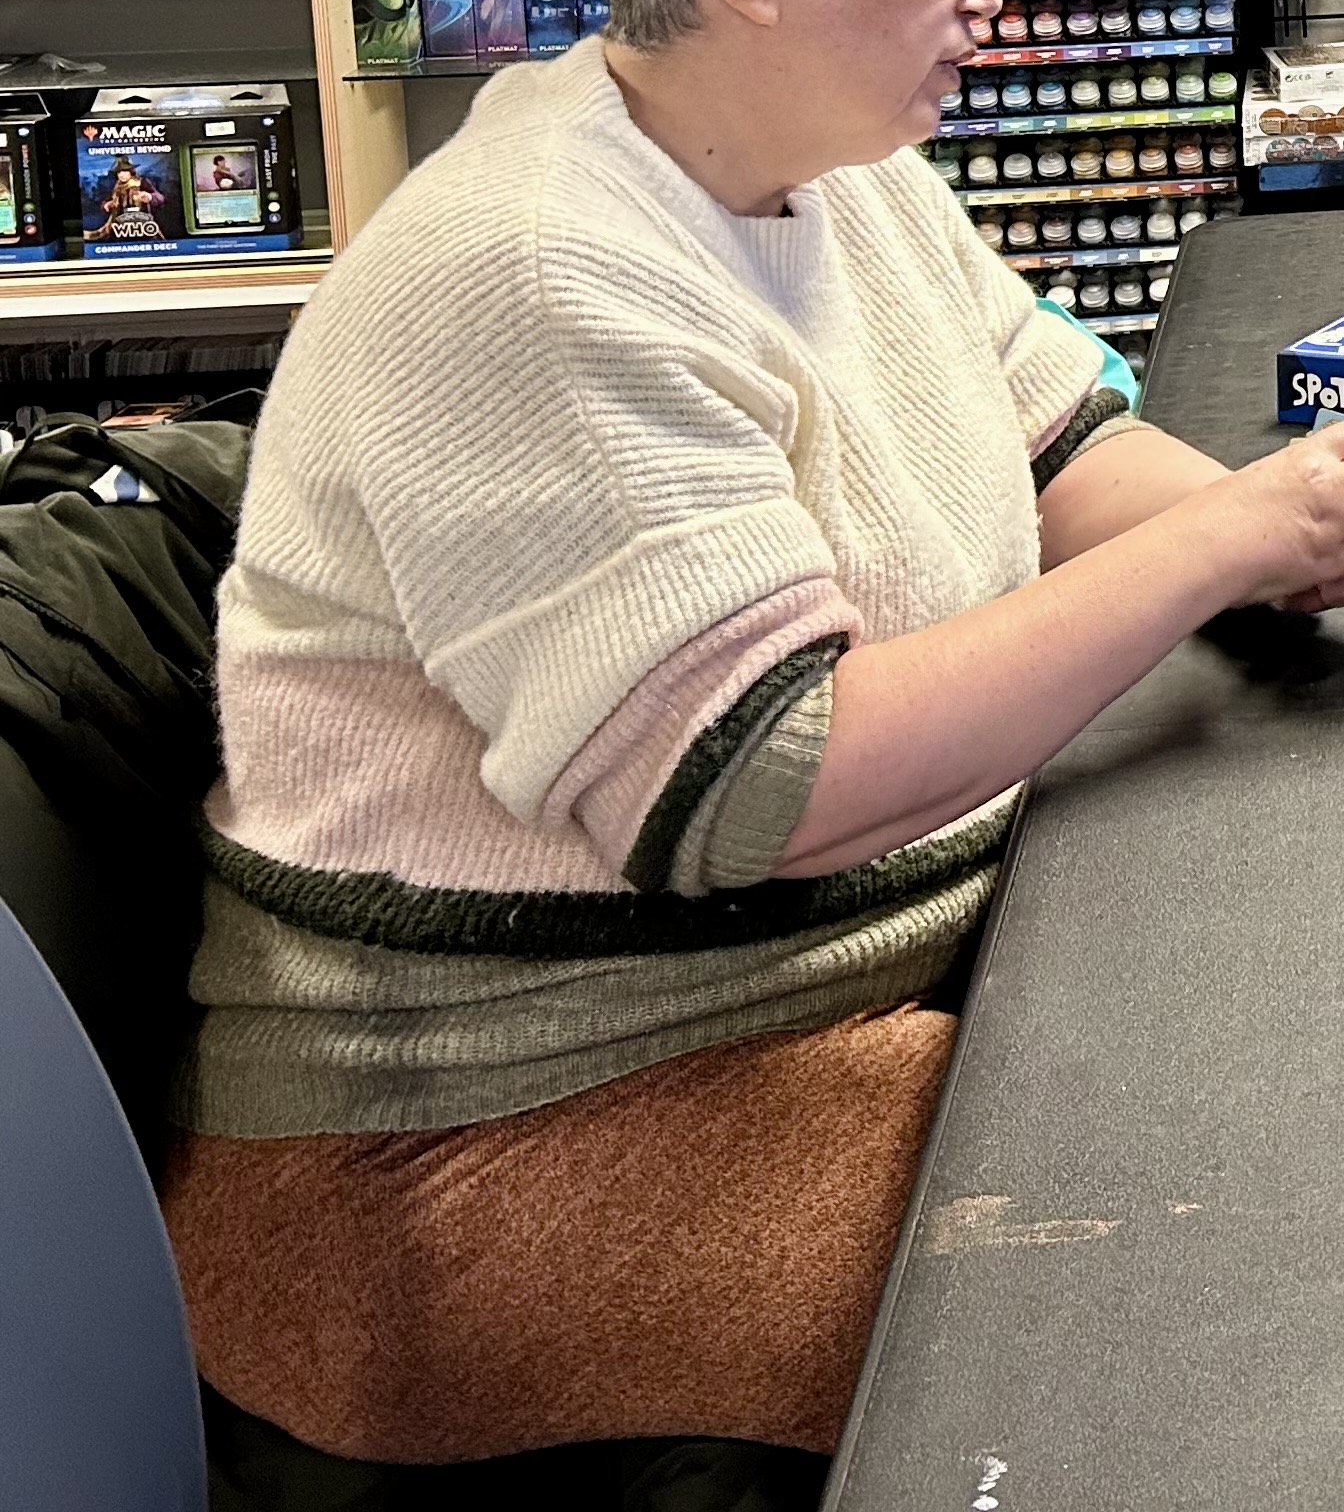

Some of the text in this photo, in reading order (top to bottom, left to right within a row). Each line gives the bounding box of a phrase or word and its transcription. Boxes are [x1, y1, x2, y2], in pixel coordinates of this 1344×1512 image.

[99, 124, 167, 139] MAGIC
[88, 145, 172, 155] UNIVERSES BEYOND
[112, 221, 160, 238] WHO
[95, 243, 178, 254] COMMANDER DECK
